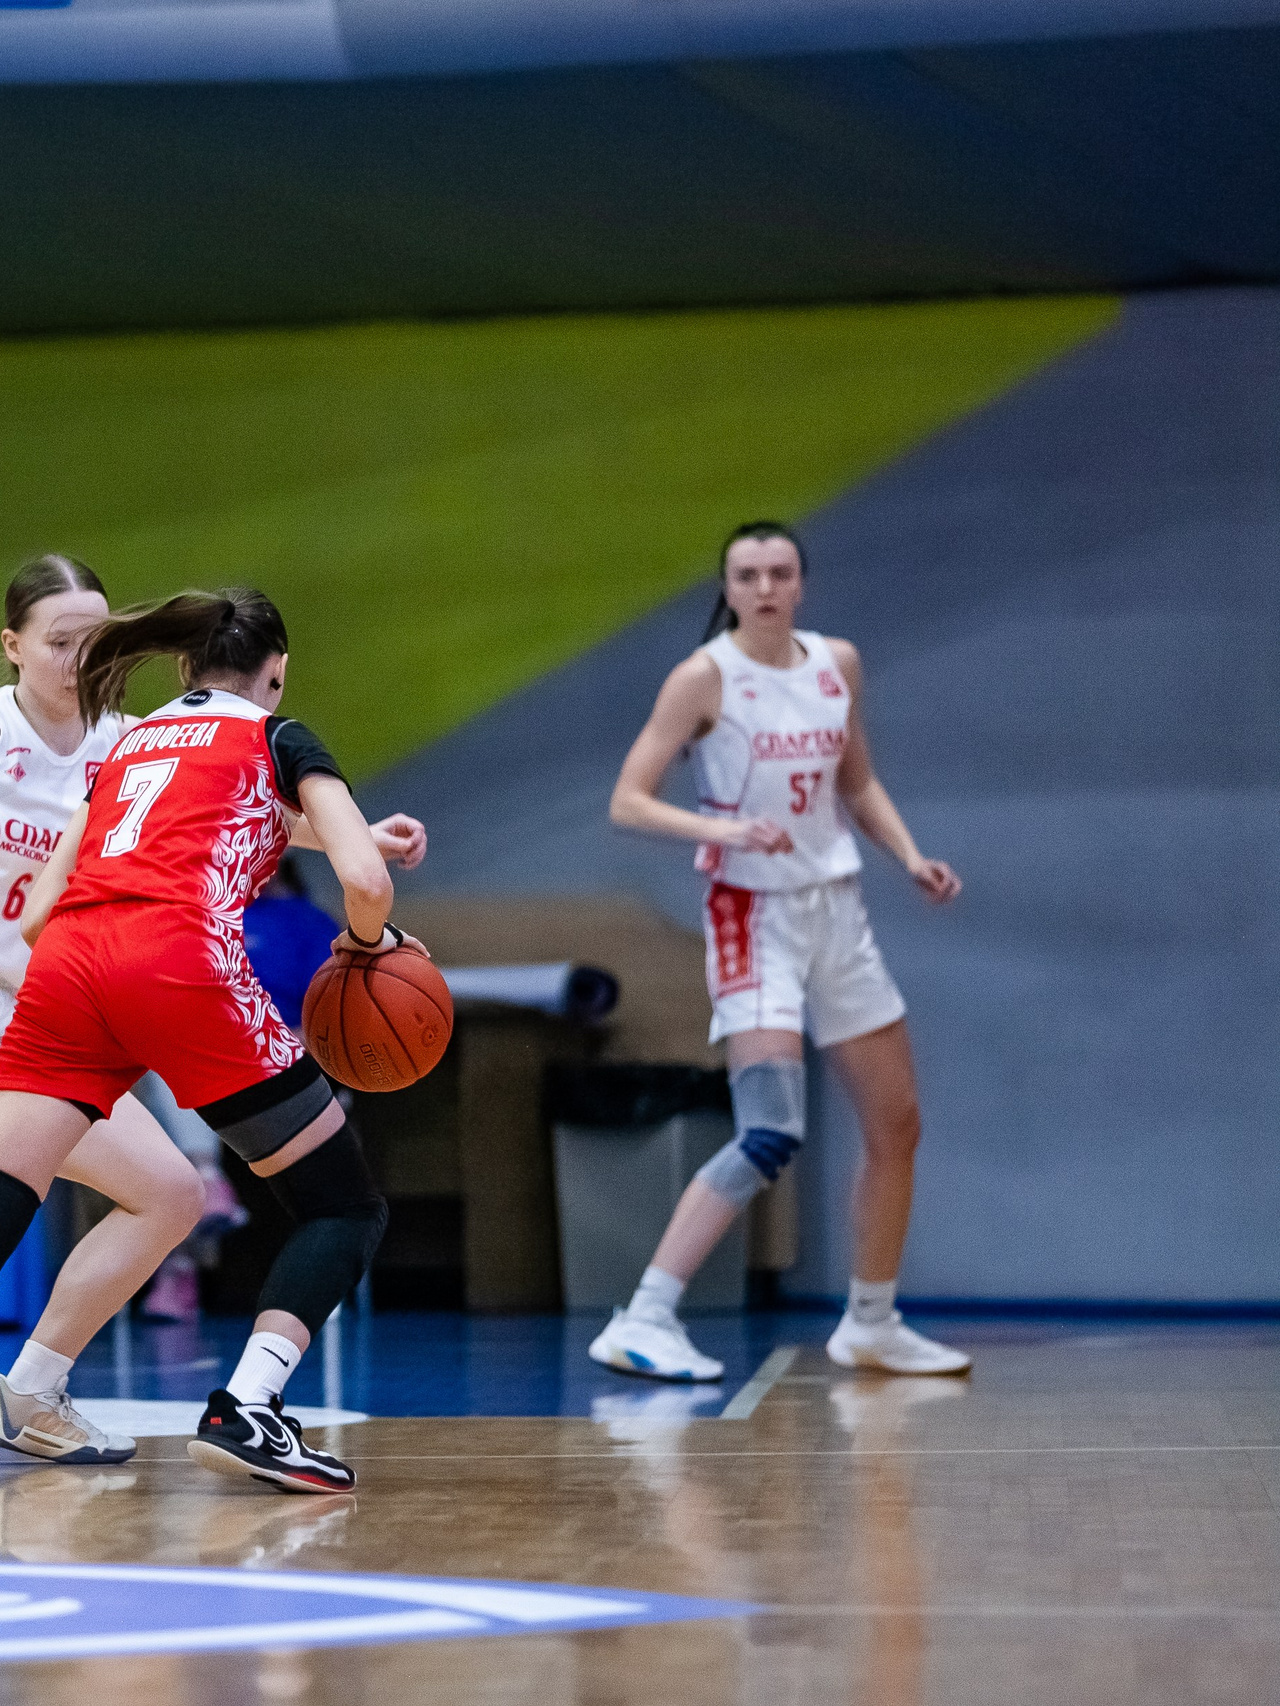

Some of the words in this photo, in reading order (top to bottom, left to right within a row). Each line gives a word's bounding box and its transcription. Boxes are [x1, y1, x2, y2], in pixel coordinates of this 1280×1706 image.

[111, 721, 221, 762] ДОРОФЕЕВА
[100, 757, 181, 858] 7
[789, 770, 824, 816] 57
[1, 872, 34, 921] 6
